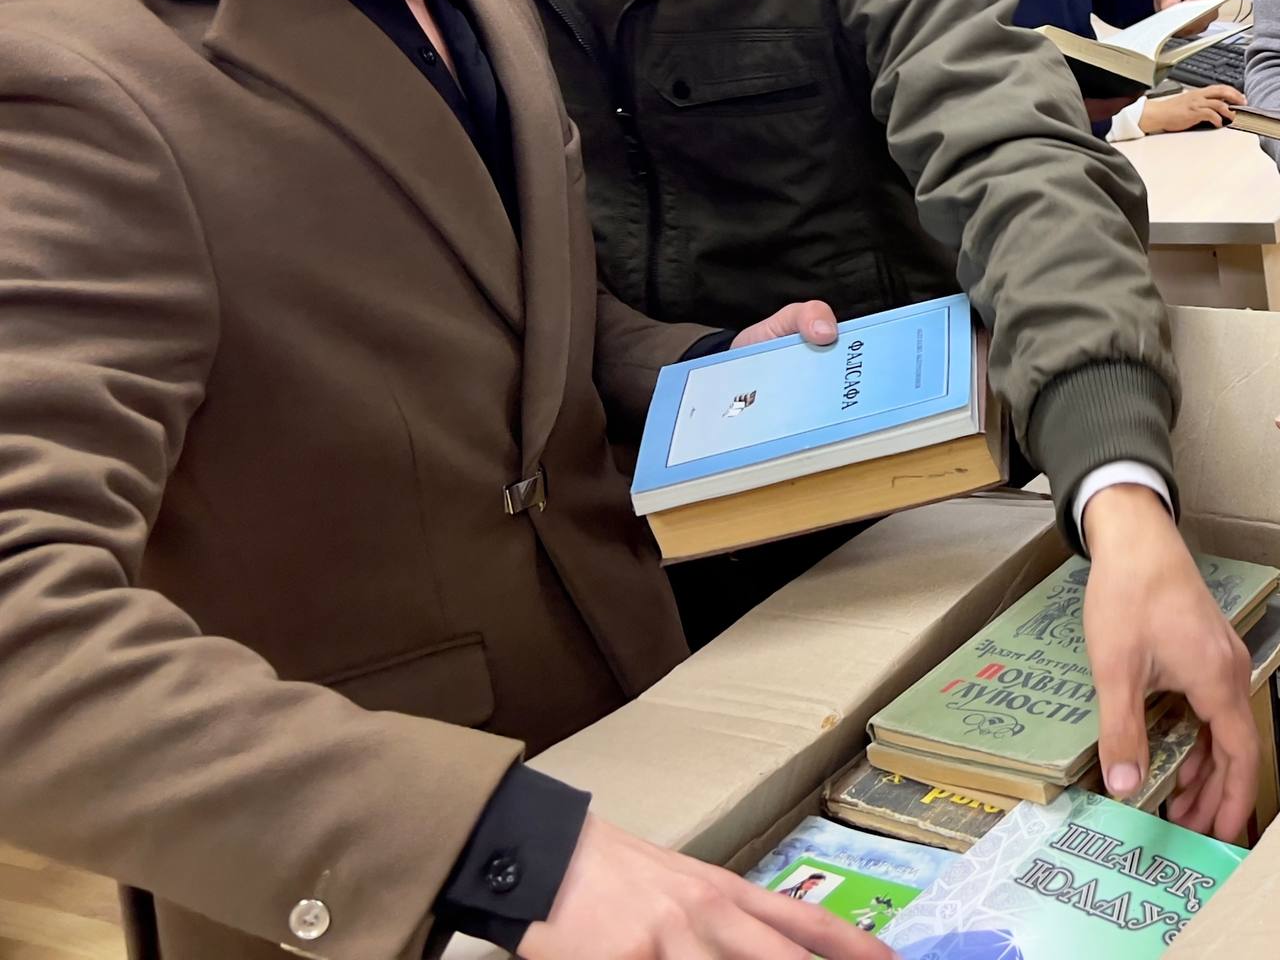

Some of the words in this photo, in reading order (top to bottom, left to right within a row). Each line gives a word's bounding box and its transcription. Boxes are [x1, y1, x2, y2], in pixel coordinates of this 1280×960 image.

[841, 340, 864, 410] ФАЛСАФА
[940, 678, 1092, 725] ГЛУПОСТИ
[976, 663, 1096, 704] ПОХВАЛА
[1050, 823, 1215, 913] ШАРҚ
